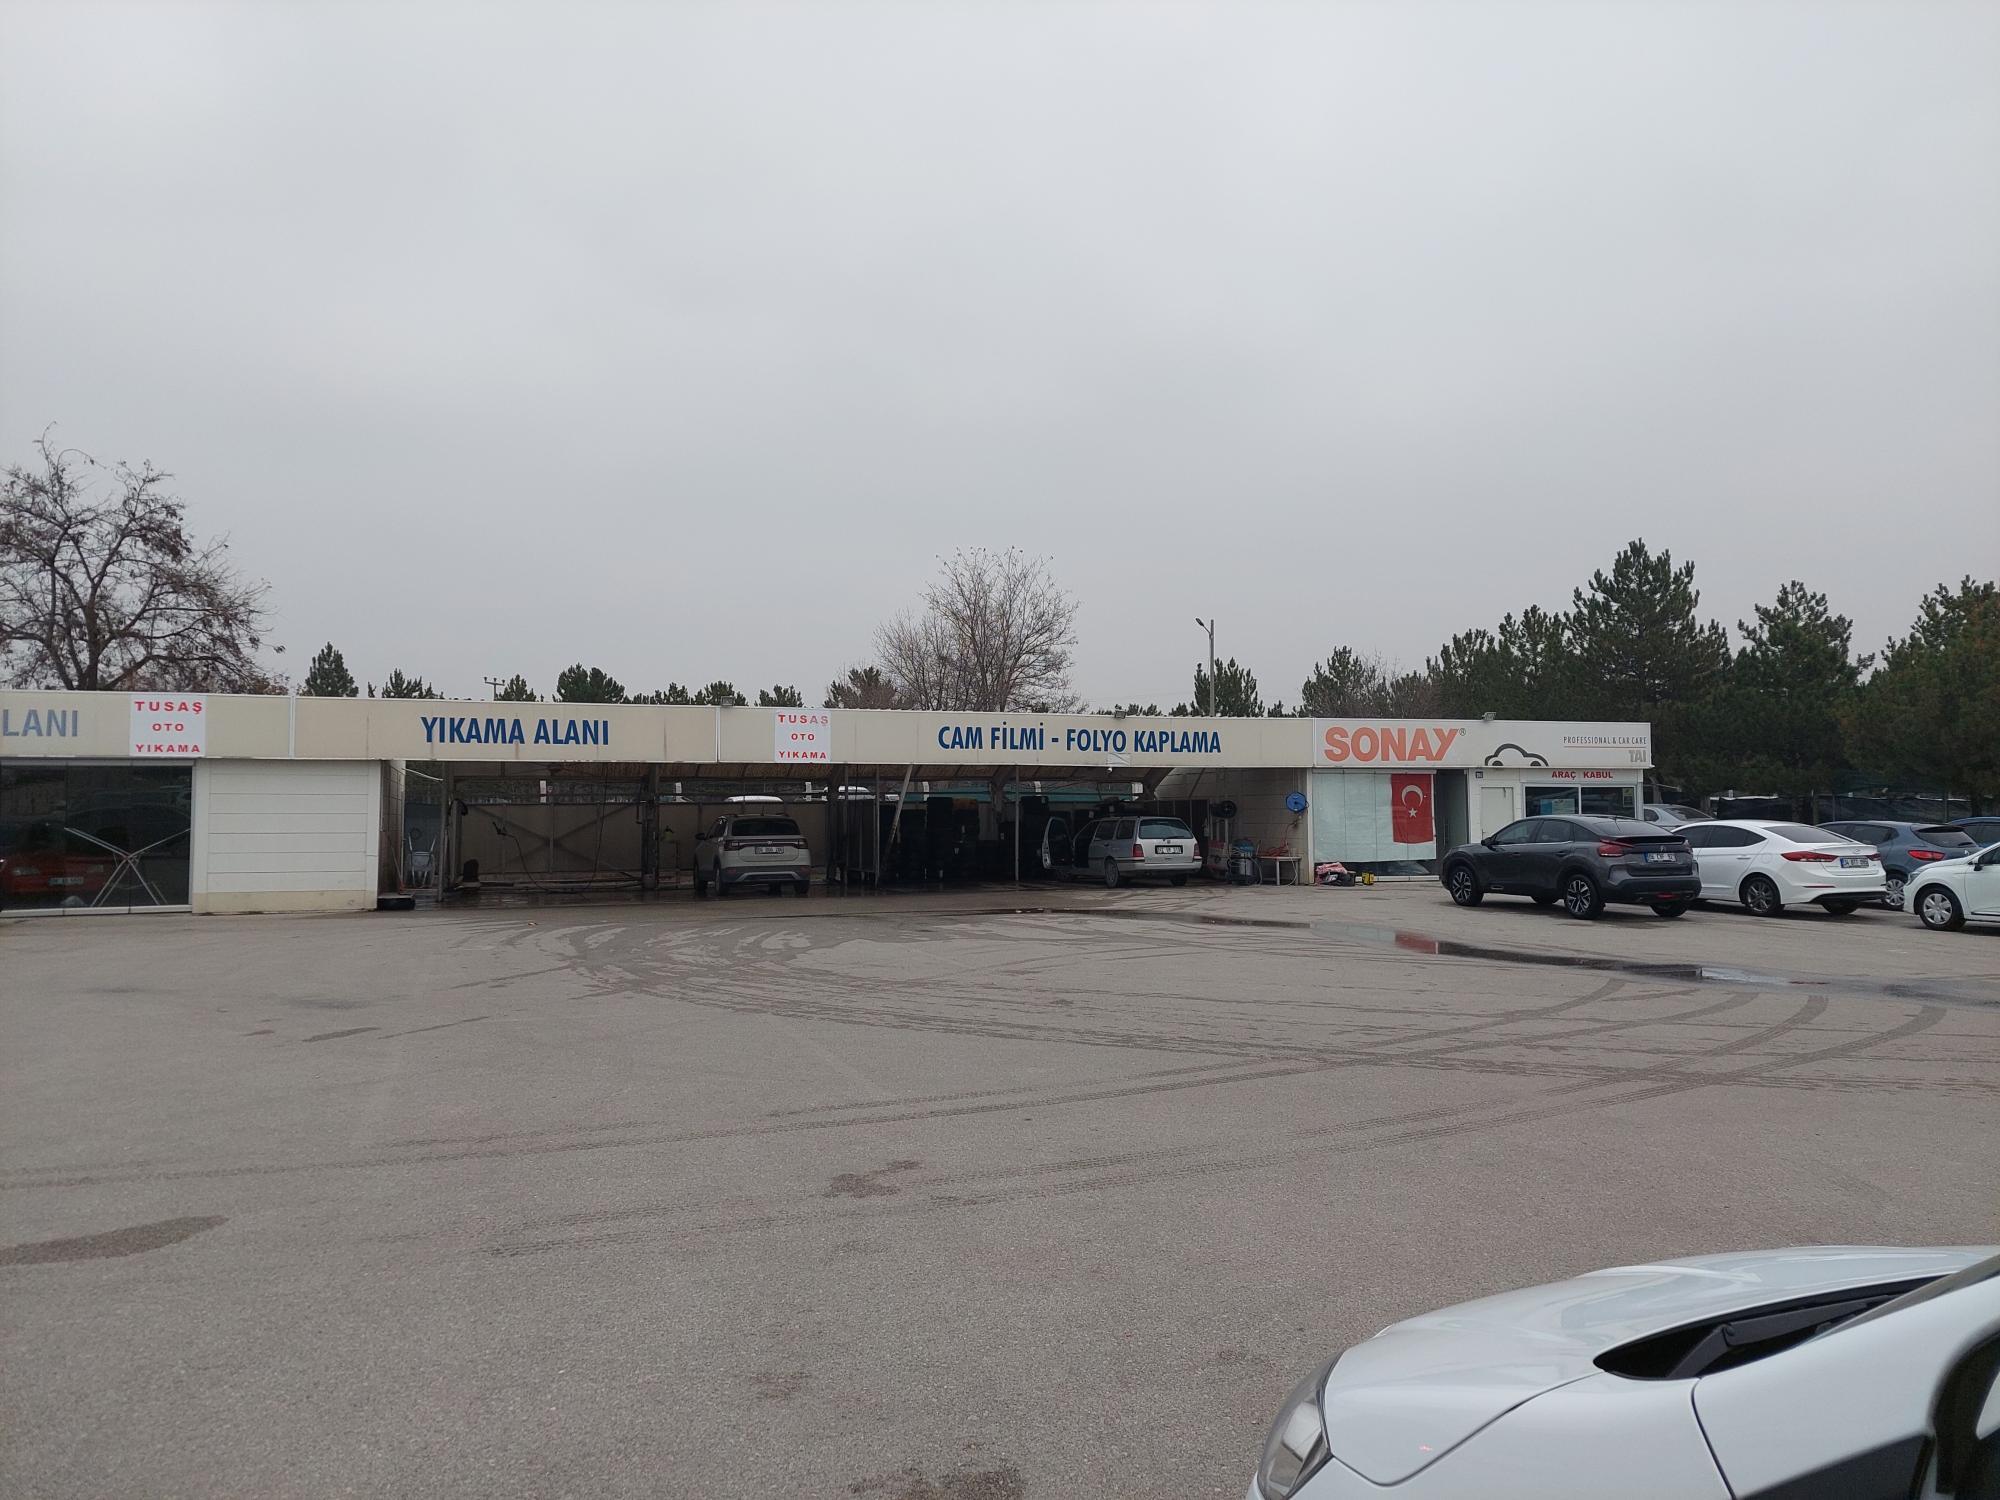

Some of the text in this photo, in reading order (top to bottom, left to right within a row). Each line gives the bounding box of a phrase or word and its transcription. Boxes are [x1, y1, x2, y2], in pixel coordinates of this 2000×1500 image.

[134, 701, 203, 714] TUSAŞ
[2, 709, 79, 737] LANI
[152, 723, 185, 732] OTO
[420, 716, 610, 746] YIKAMA ALANI
[791, 733, 815, 741] OTO
[938, 726, 984, 750] CAM
[990, 721, 1045, 750] FİLMİ
[1066, 728, 1127, 752] FOLYO
[1133, 730, 1222, 753] KAPLAMA
[1563, 736, 1611, 744] PROFESSIONAL
[1618, 736, 1630, 744] CAR
[1631, 736, 1647, 745] CARE
[136, 744, 201, 753] YIKAMA
[1324, 726, 1459, 762] SONAY
[779, 751, 827, 759] YIKAMA
[1551, 771, 1613, 780] ARAÇ KABUL
